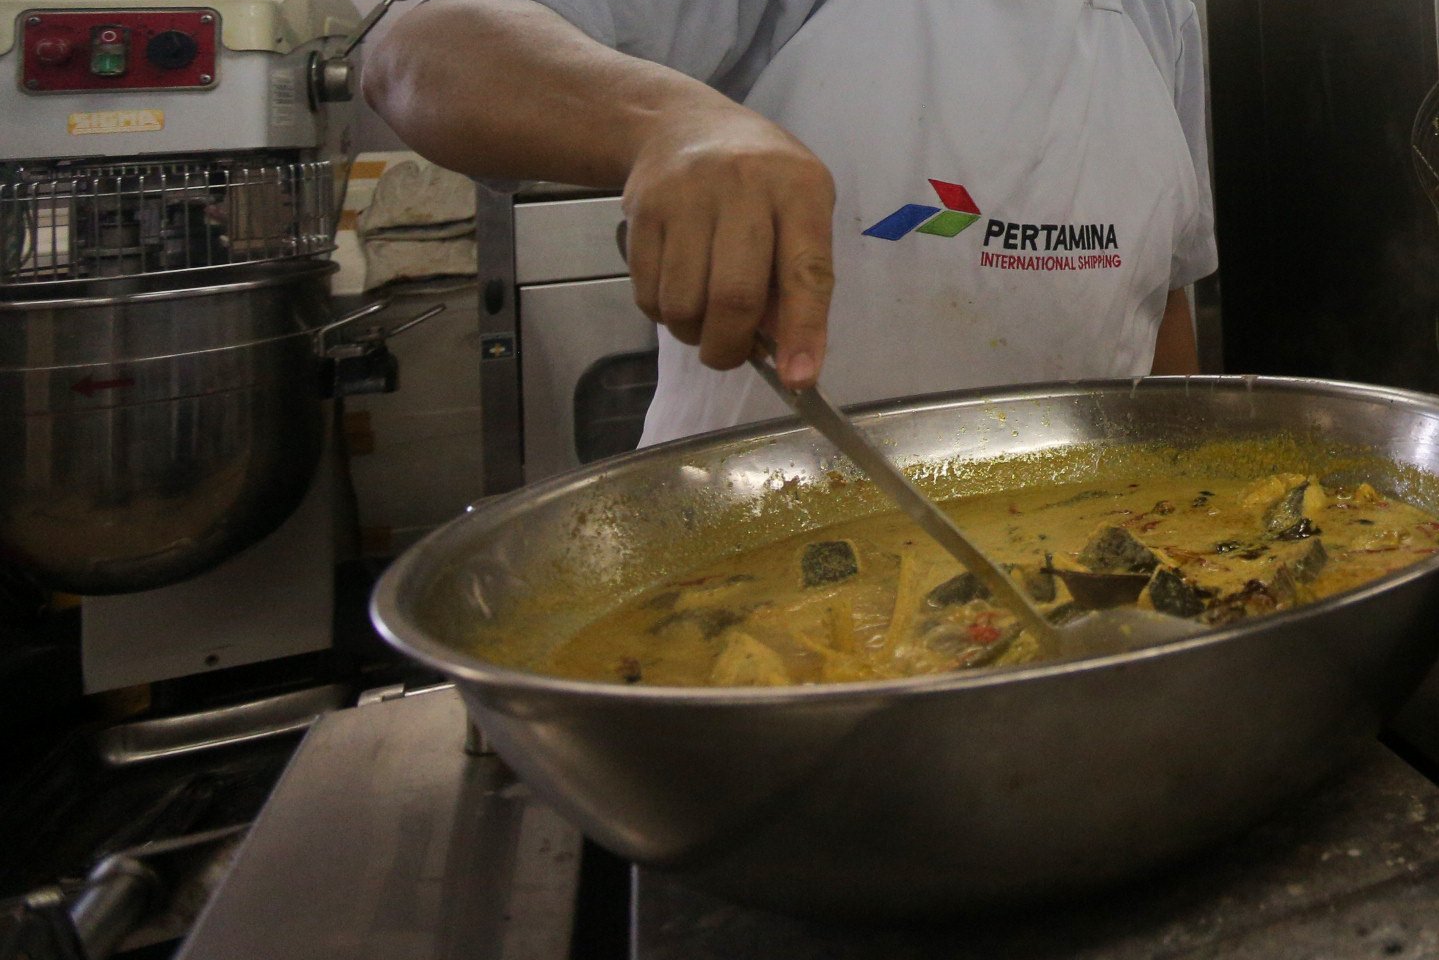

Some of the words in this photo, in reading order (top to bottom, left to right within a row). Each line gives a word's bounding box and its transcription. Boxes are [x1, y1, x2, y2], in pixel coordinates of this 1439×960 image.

[71, 111, 162, 135] SIGMA
[983, 218, 1119, 251] PERTAMINA
[980, 251, 1077, 271] INTERNATIONAL
[1077, 254, 1122, 270] SHIPPING
